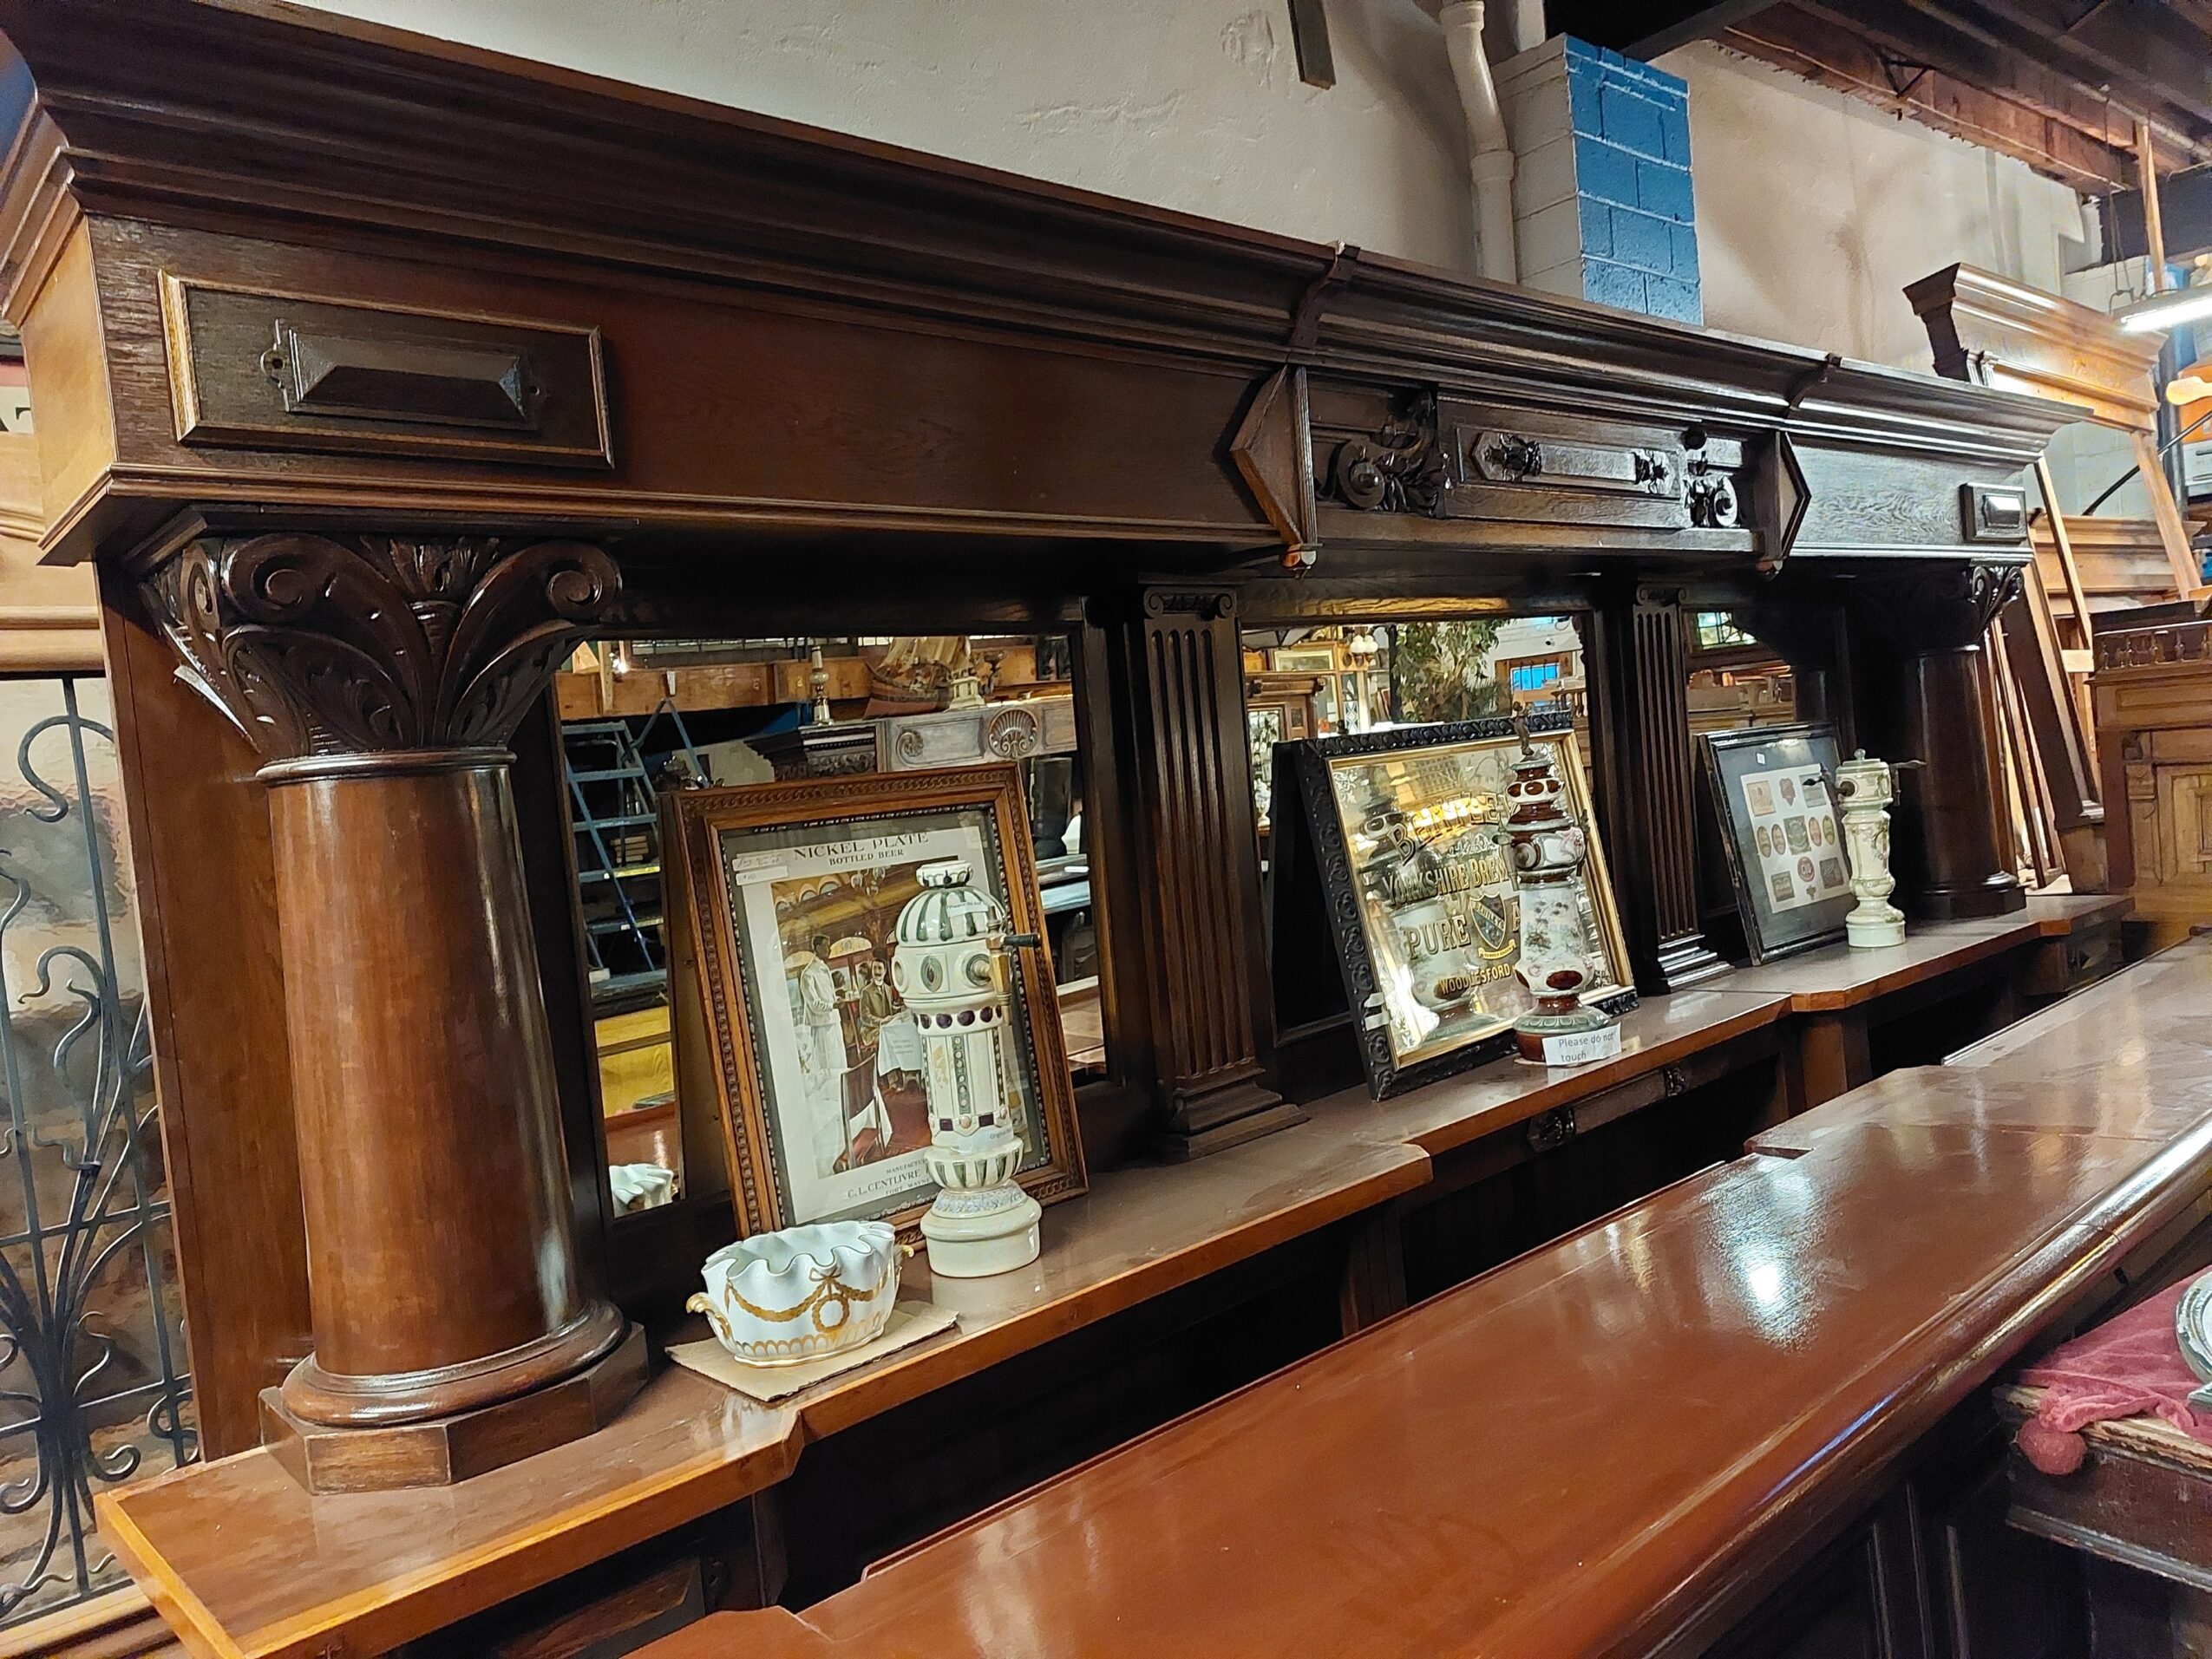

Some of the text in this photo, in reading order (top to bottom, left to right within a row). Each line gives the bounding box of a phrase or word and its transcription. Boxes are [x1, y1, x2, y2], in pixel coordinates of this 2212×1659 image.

[794, 833, 929, 860] NICKEL PLATE
[829, 849, 904, 865] BOTTLED BEER
[1382, 865, 1469, 906] YORKSHIRE
[1403, 914, 1471, 960] PURE
[1438, 963, 1510, 995] WOODLESFORD
[1559, 1032, 1614, 1048] Please do not
[1561, 1050, 1587, 1062] touch
[867, 1169, 921, 1192] CENTLIVRE
